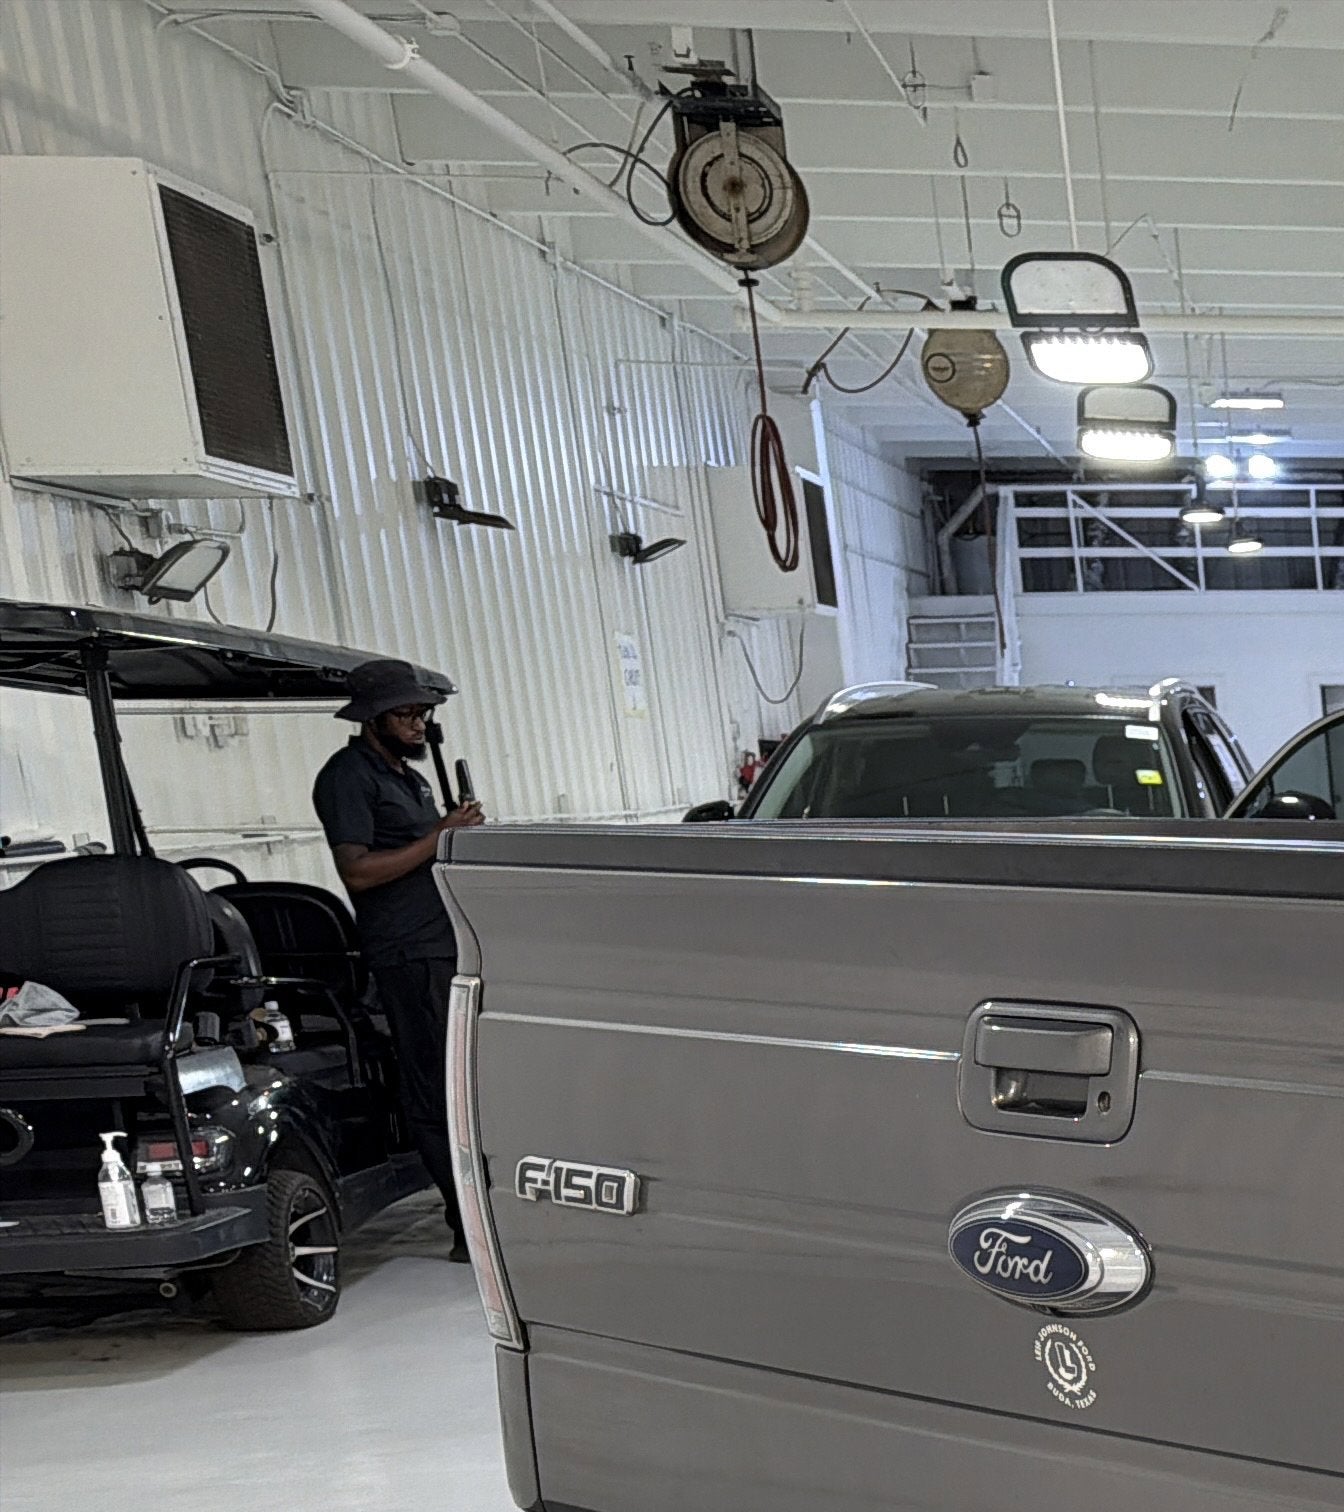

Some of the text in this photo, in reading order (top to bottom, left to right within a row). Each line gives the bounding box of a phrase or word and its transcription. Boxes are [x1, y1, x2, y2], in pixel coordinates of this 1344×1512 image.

[516, 1156, 636, 1215] F-150
[974, 1228, 1053, 1285] Ford
[1038, 1324, 1077, 1341] JOHNSON
[1077, 1340, 1096, 1371] FORD
[1075, 1389, 1097, 1409] TEXAS
